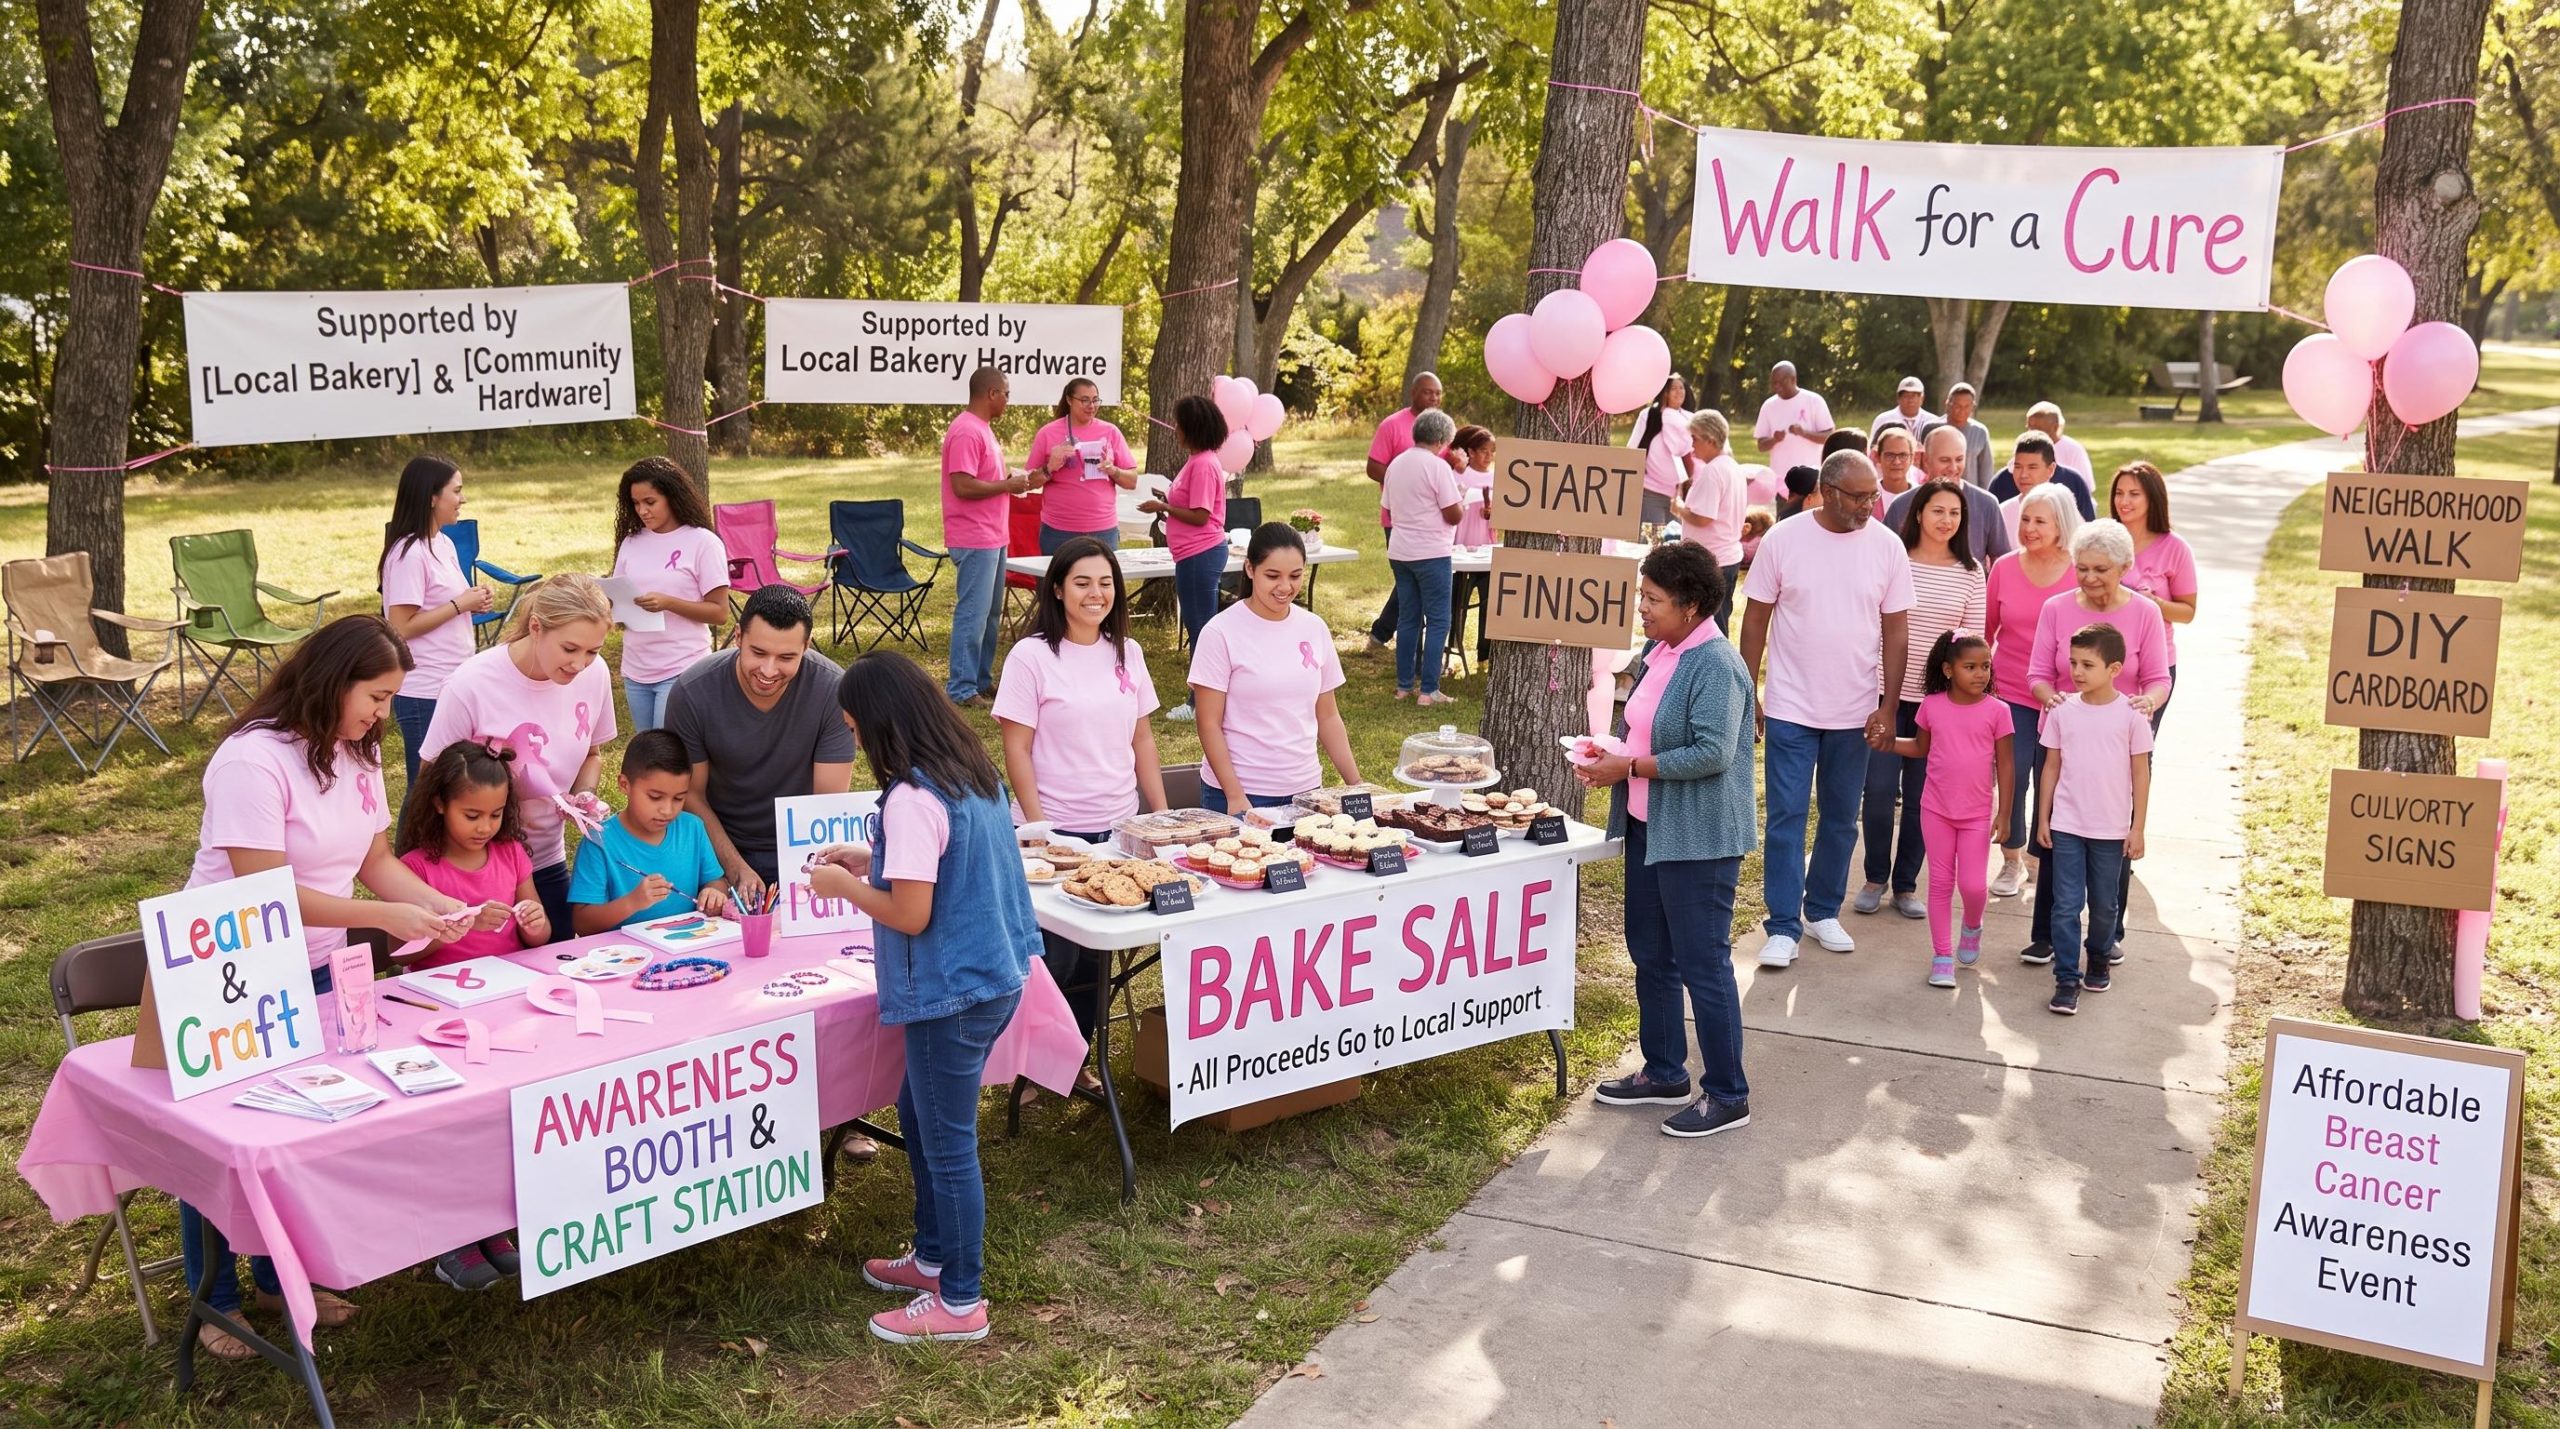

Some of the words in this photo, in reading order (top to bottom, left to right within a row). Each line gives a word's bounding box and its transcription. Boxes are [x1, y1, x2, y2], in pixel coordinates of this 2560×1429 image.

[1711, 157, 1895, 263] Walk
[1915, 183, 1994, 256] for
[2010, 211, 2041, 250] a
[2064, 167, 2247, 275] Cure
[317, 303, 475, 343] Supported
[486, 302, 518, 338] by
[861, 311, 990, 341] Supported
[998, 313, 1027, 343] by
[202, 363, 298, 403] [Local
[309, 358, 421, 395] Bakery]
[433, 363, 455, 394] &
[464, 342, 621, 382] [Community
[781, 344, 859, 373] Local
[869, 346, 967, 381] Bakery
[977, 347, 1107, 376] Hardware
[478, 378, 611, 412] Hardware]
[1503, 458, 1638, 516] START
[2332, 485, 2522, 524] NEIGHBORHOOD
[2364, 526, 2472, 569] WALK
[1496, 572, 1628, 628] FINISH
[2367, 608, 2469, 664] DIY
[2332, 670, 2489, 715] CARDBOARD
[2350, 793, 2475, 828] CULVORTY
[2365, 834, 2457, 870] SIGNS
[156, 900, 290, 969] Learn
[1188, 914, 1378, 1041] BAKE
[1398, 879, 1552, 994] SALE
[222, 961, 249, 1004] &
[177, 989, 300, 1078] Craft
[1189, 1056, 1218, 1095] All
[1226, 1033, 1330, 1085] Proceeds
[1337, 1027, 1367, 1055] Go
[1373, 1022, 1394, 1050] to
[1402, 1001, 1456, 1044] Local
[1462, 985, 1543, 1030] Support
[534, 1032, 799, 1154] AWARENESS
[2291, 1063, 2481, 1123] Affordable
[605, 1114, 733, 1194] BOOTH
[750, 1103, 776, 1150] &
[2324, 1114, 2440, 1166] Breast
[536, 1195, 658, 1277] CRAFT
[673, 1150, 810, 1234] STATION
[2314, 1160, 2441, 1213] Cancer
[2273, 1202, 2472, 1268] Awareness
[2317, 1256, 2417, 1307] Event
